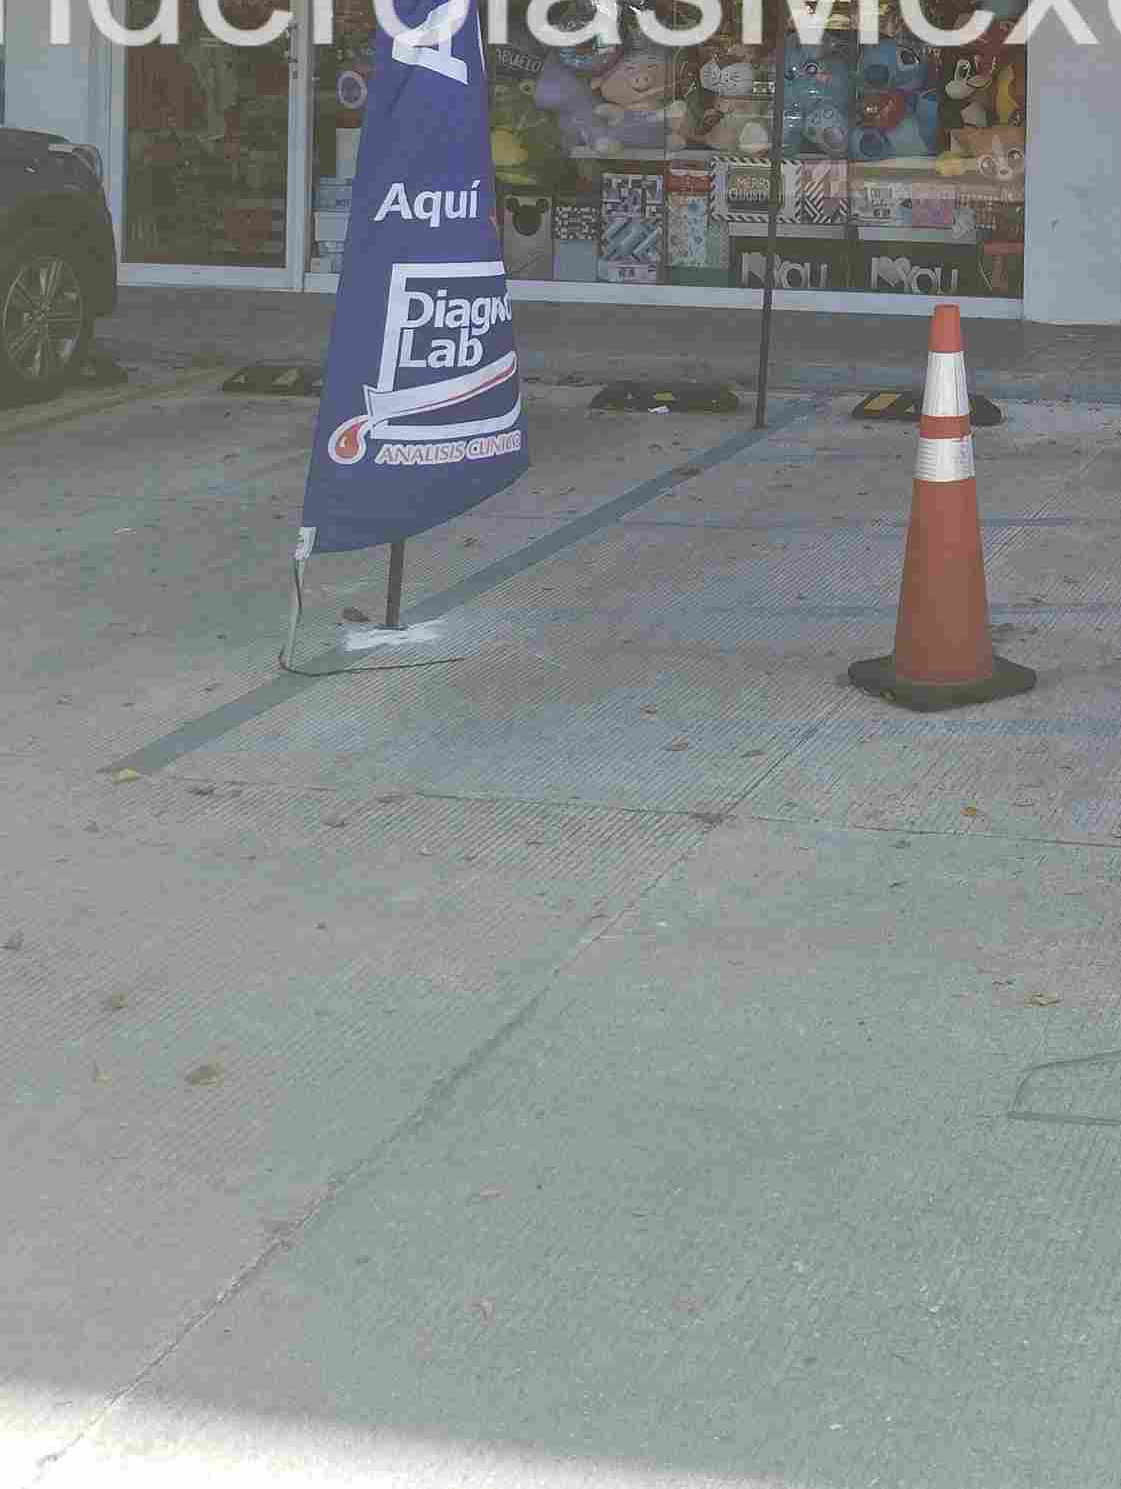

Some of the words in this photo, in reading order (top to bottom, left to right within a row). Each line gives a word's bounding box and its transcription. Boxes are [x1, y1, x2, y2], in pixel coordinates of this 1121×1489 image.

[374, 180, 481, 227] Aquí
[399, 327, 484, 368] Lab
[375, 441, 467, 465] ANALISIS
